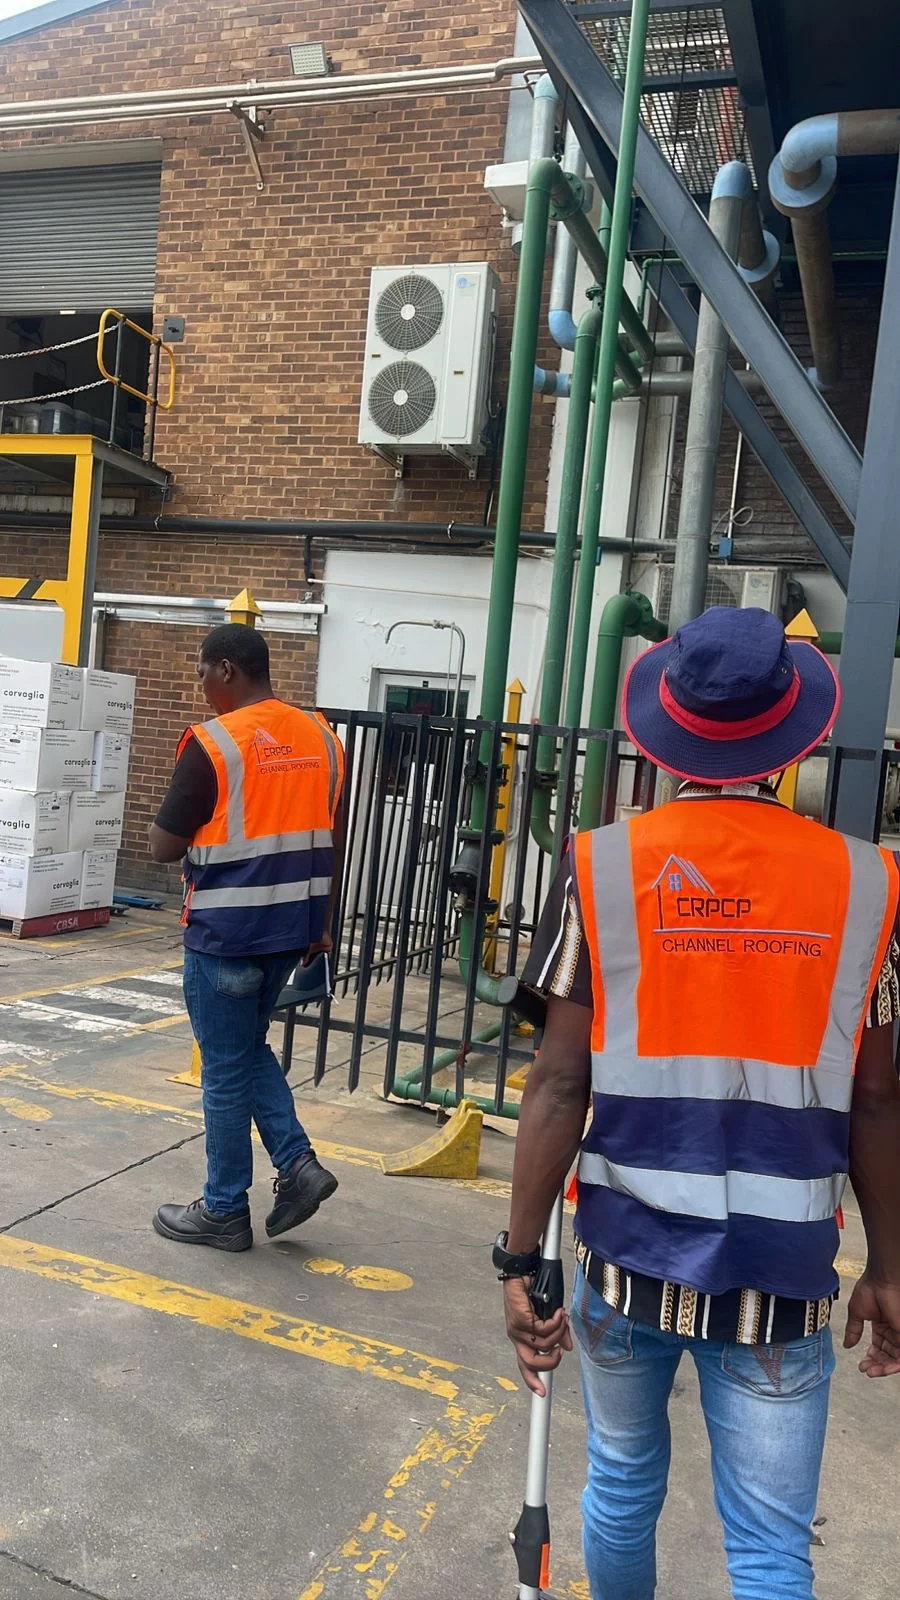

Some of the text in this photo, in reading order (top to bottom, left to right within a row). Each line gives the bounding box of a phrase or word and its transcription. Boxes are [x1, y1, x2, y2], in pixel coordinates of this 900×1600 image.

[3, 690, 45, 700] corvaglia
[107, 700, 133, 711] corvaglia
[264, 746, 292, 757] CRPCP
[64, 758, 91, 768] corvaglia
[260, 762, 320, 774] CHANNEL ROOFING
[95, 817, 121, 827] corvaglia
[52, 878, 80, 890] corvaglia
[676, 897, 752, 919] CRPCP
[662, 938, 822, 957] CHANNEL ROOFING
